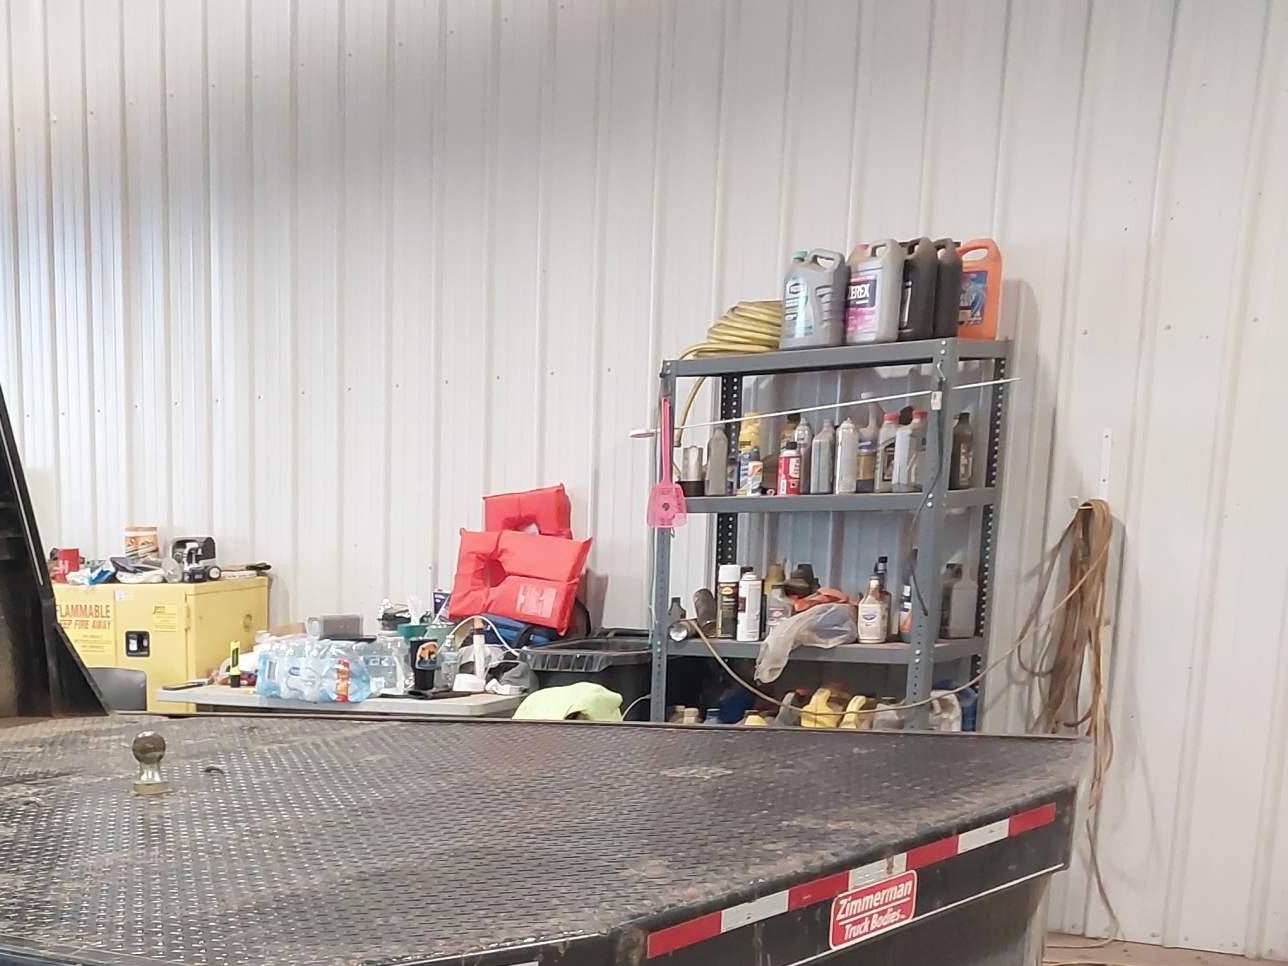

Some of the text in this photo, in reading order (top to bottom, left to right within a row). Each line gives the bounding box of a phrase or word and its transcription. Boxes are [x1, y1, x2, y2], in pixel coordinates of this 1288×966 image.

[849, 284, 870, 300] EREX
[92, 619, 112, 630] AWAY
[836, 880, 912, 920] Zimmerman
[844, 907, 901, 940] Truck Bodies
